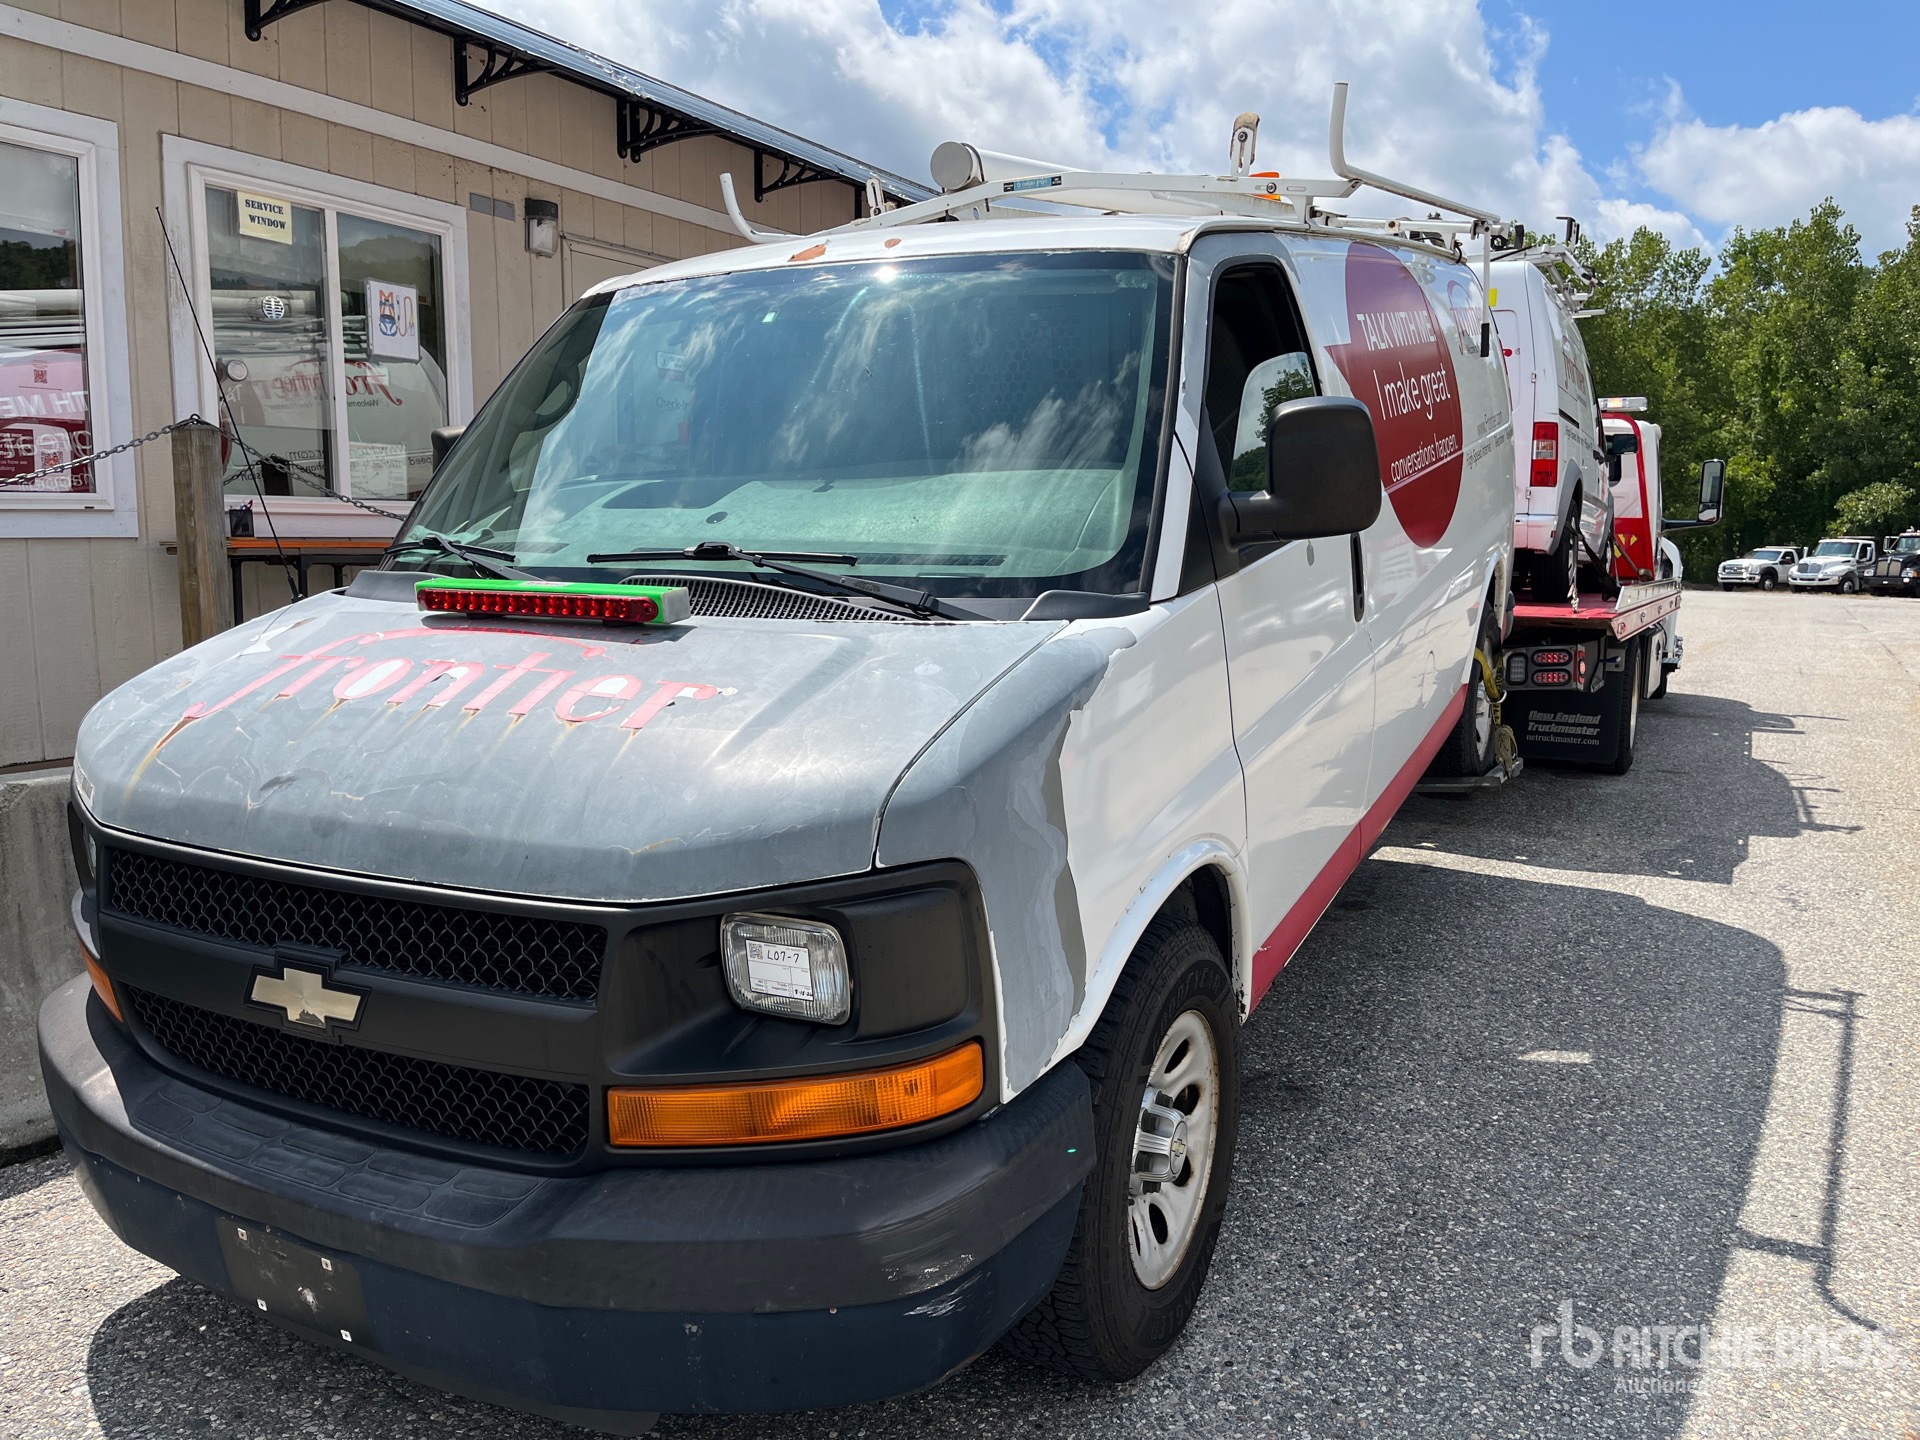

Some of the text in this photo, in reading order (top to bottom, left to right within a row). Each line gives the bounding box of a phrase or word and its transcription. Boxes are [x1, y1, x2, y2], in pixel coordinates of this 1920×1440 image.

[245, 199, 284, 215] SERVICE
[248, 214, 286, 230] WINDOW
[1356, 312, 1393, 351] TALK
[1388, 312, 1419, 348] WITH
[1372, 361, 1451, 421] I make great
[1390, 441, 1436, 482] conversations
[1528, 710, 1601, 725] New England
[1527, 722, 1600, 736] Truckmaster
[1526, 734, 1600, 746] netruckmaster.com
